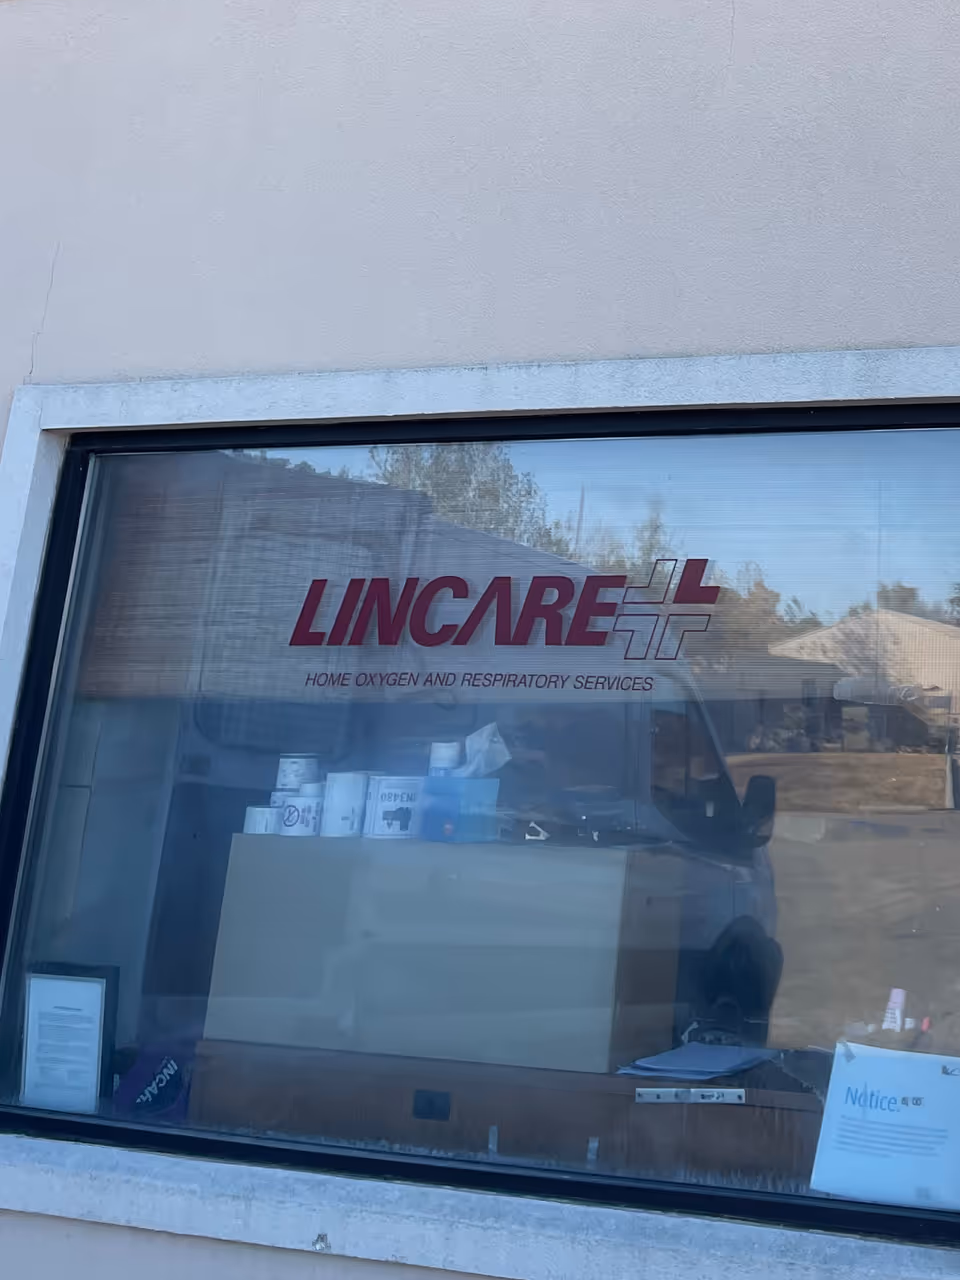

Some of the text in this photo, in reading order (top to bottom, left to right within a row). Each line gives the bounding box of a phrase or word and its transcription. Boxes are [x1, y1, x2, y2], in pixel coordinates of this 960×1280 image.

[289, 575, 627, 648] LINCARE
[305, 672, 654, 692] HOME OXYGEN AND RESPIRATORY SERVICES
